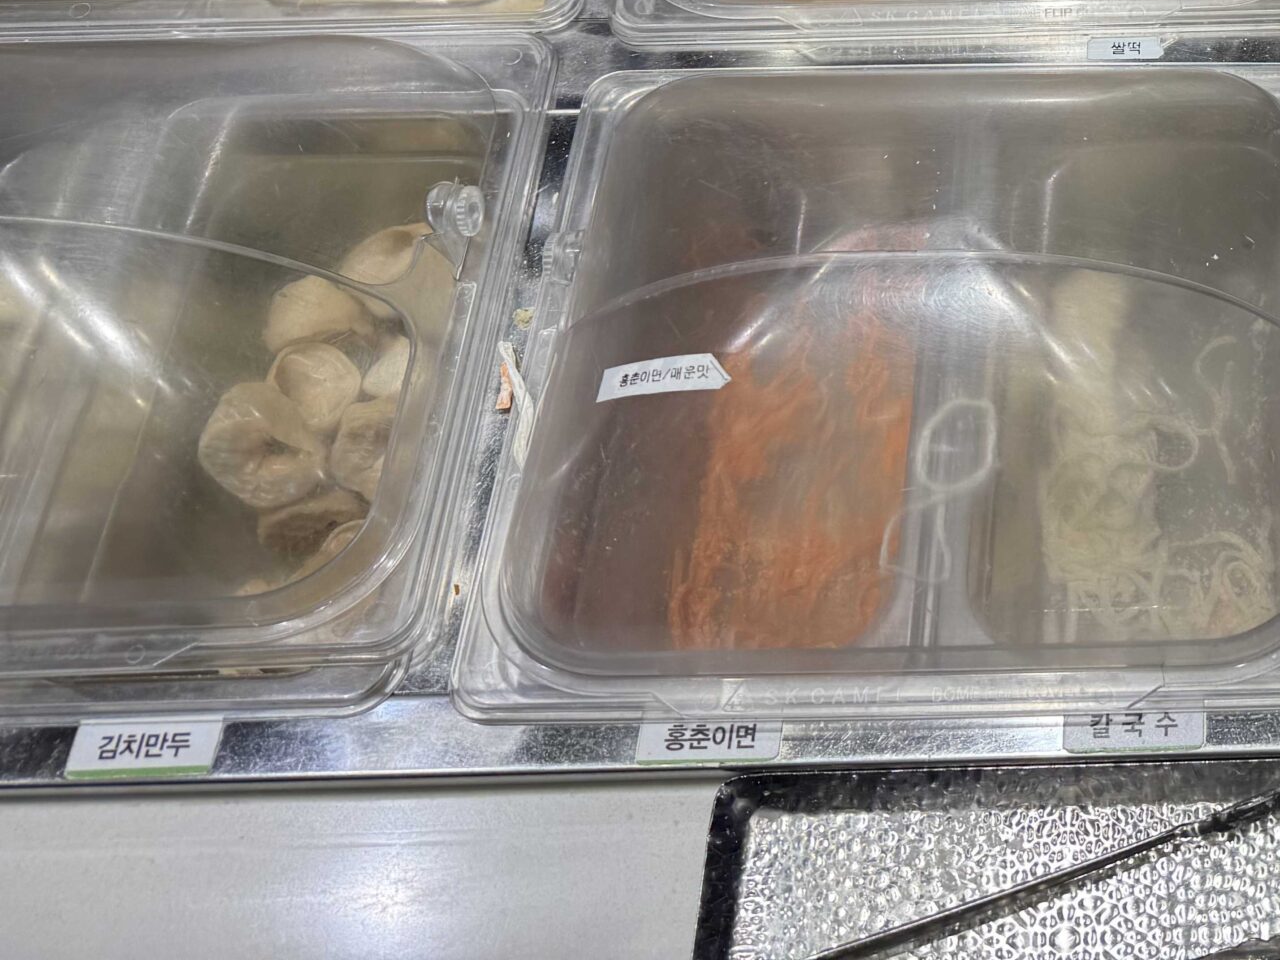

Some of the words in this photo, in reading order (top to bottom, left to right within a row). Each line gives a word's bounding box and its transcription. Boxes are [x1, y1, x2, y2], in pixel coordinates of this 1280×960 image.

[1111, 41, 1141, 55] 쌀떡
[664, 723, 758, 751] 홍춘이면
[1089, 711, 1179, 739] 칼국수
[97, 732, 192, 760] 김치만두
